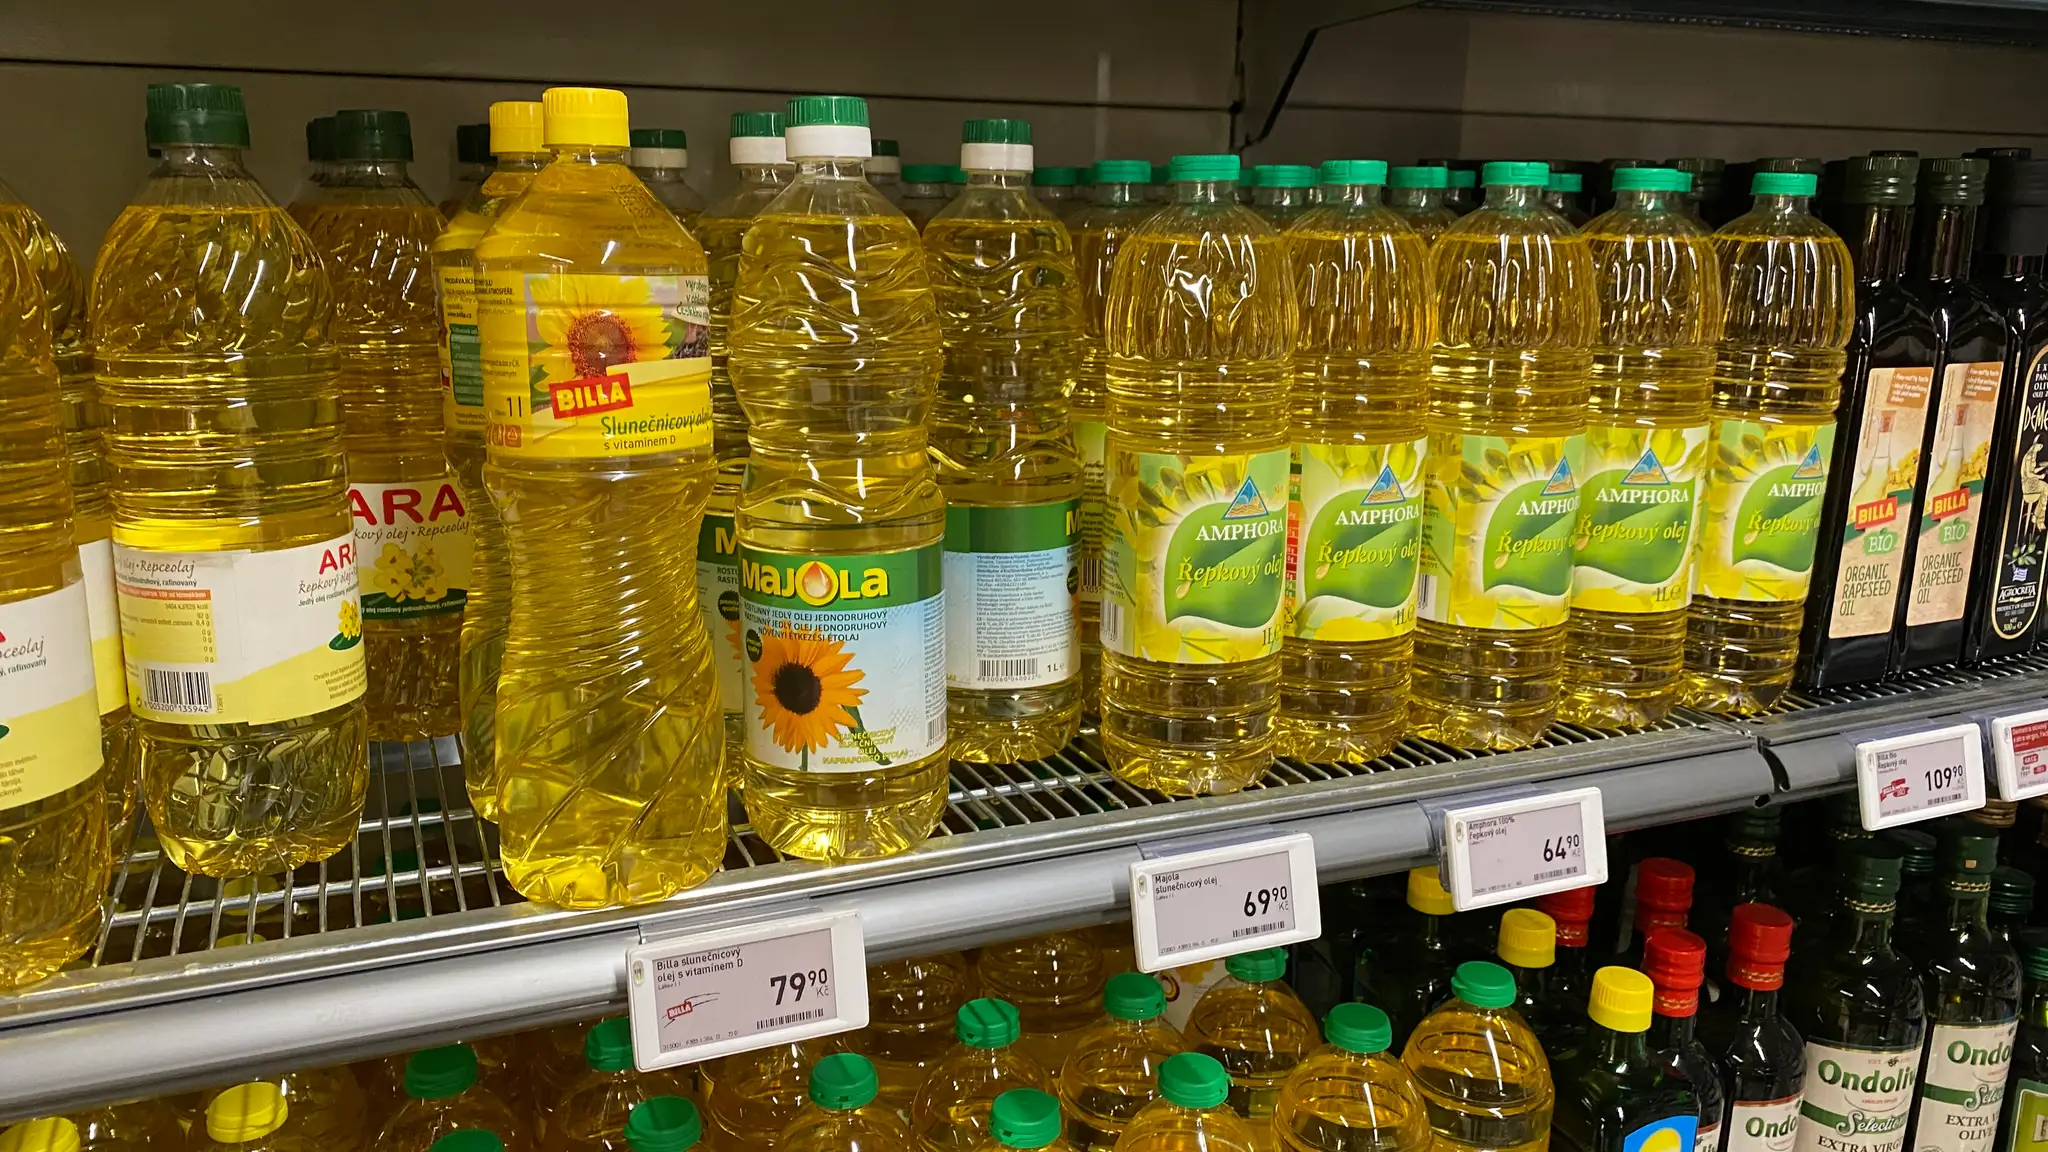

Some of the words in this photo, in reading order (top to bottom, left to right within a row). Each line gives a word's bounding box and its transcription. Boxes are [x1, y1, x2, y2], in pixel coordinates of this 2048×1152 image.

[556, 381, 628, 412] BILLA
[601, 410, 694, 436] Slunečnicový
[604, 442, 610, 450] s
[670, 434, 676, 444] D
[348, 484, 465, 526] ARA
[1595, 488, 1689, 504] AMPHORA
[1934, 492, 1966, 515] BILLA
[1334, 504, 1420, 526] AMPHORA
[1748, 508, 1811, 537] Řepkový
[1858, 502, 1894, 524] BILLA
[354, 528, 382, 544] kový
[386, 526, 408, 544] olej
[1195, 518, 1284, 542] AMPHORA
[1574, 514, 1660, 546] Řepkový
[1663, 520, 1688, 544] olej
[1943, 524, 1966, 542] BIO
[1316, 540, 1399, 570] Řepkový
[1400, 536, 1420, 562] olej
[1496, 530, 1566, 560] Řepkový
[1868, 534, 1894, 553] BIO
[140, 560, 195, 579] Repceolaj
[1176, 556, 1262, 588] Řepkový
[1264, 552, 1284, 579] olej
[1922, 552, 1962, 572] ORGANIC
[1845, 563, 1890, 582] ORGANIC
[1919, 568, 1964, 588] RAPESEED
[1842, 580, 1892, 599] RAPESEED
[1916, 588, 1930, 604] OIL
[772, 606, 792, 620] JEDLÝ
[794, 612, 812, 622] OLEJ
[814, 610, 888, 622] JEDNODRUHOVÝ
[1840, 600, 1855, 616] OIL
[772, 616, 792, 630] JEDLÝ
[794, 622, 812, 632] OLEJ
[814, 620, 888, 632] JEDNODRUHOVÝ
[827, 632, 860, 642] ÉTOLAJ
[8, 658, 47, 676] rafinovaný
[1925, 767, 1952, 792] 109
[1468, 820, 1497, 830] Amphora
[1499, 816, 1516, 824] 100%
[1495, 826, 1507, 836] olej
[1543, 836, 1567, 862] 64
[1155, 872, 1180, 885] Majola
[1156, 879, 1202, 894] slunečnicový
[1204, 876, 1218, 886] olej
[1244, 888, 1271, 918] 69
[1278, 900, 1290, 912] Kč
[656, 959, 679, 971] Billa
[681, 946, 742, 967] slunečnicový
[658, 970, 675, 982] olej
[678, 971, 684, 979] s
[736, 958, 744, 968] D
[770, 972, 806, 1006] 79
[816, 984, 830, 999] Kč
[669, 1003, 692, 1018] BILLA
[1947, 1040, 2012, 1066] Ondo
[1745, 1112, 1798, 1139] Ondo
[1945, 1114, 1990, 1128] EXTRA
[1818, 1134, 1869, 1152] EXTRA
